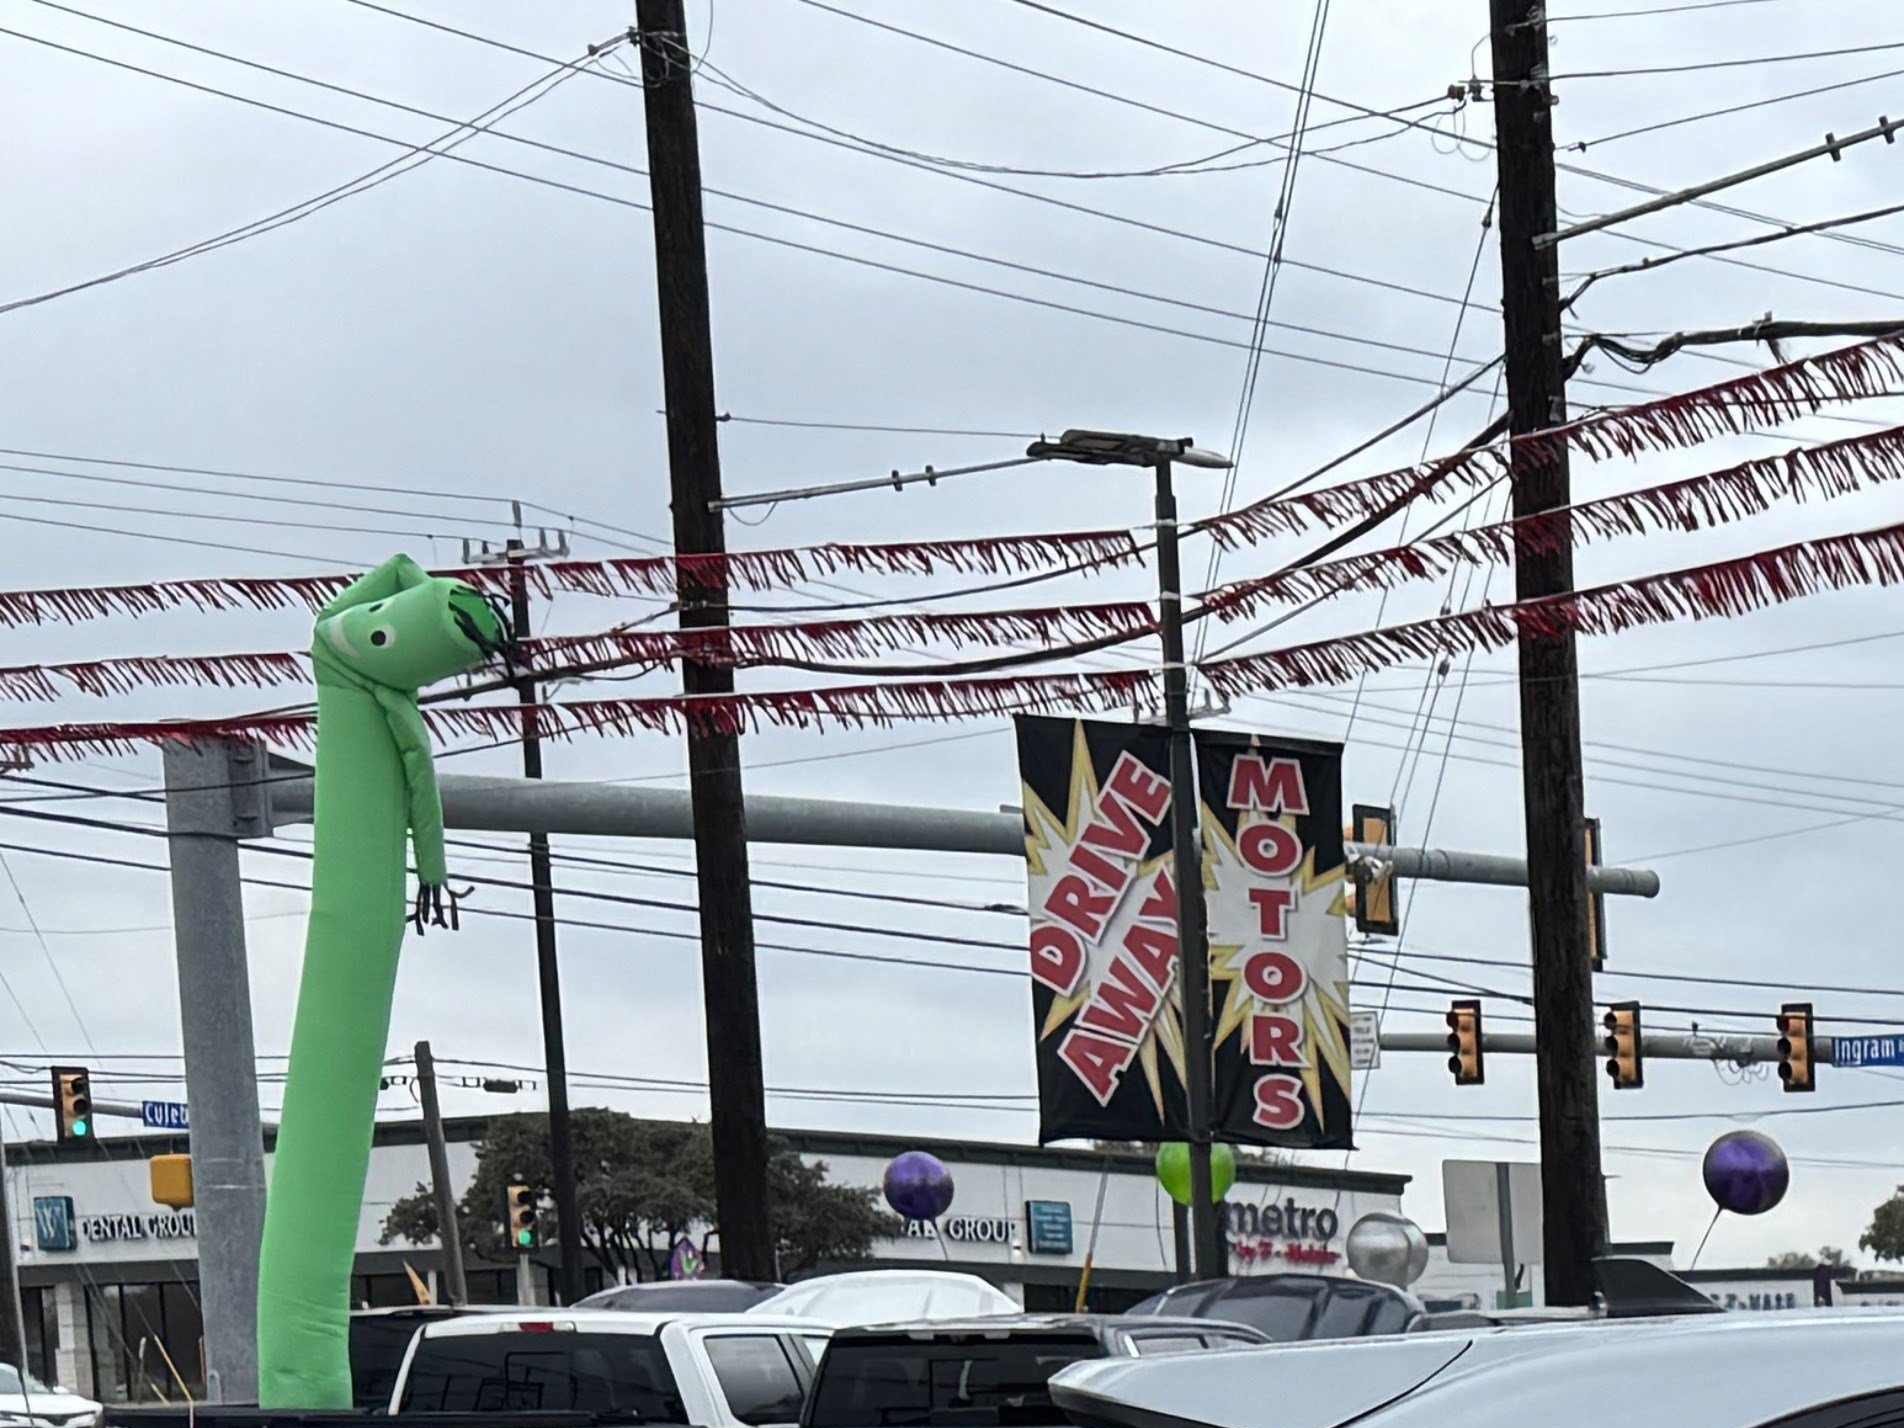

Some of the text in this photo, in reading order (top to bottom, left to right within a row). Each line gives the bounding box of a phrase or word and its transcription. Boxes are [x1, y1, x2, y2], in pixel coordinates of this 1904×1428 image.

[1031, 750, 1172, 997] DRIVE
[1227, 753, 1310, 1130] MOTORS
[1834, 1038, 1896, 1065] Ingram
[949, 1217, 1018, 1242] GROUP
[1221, 1197, 1339, 1241] metro
